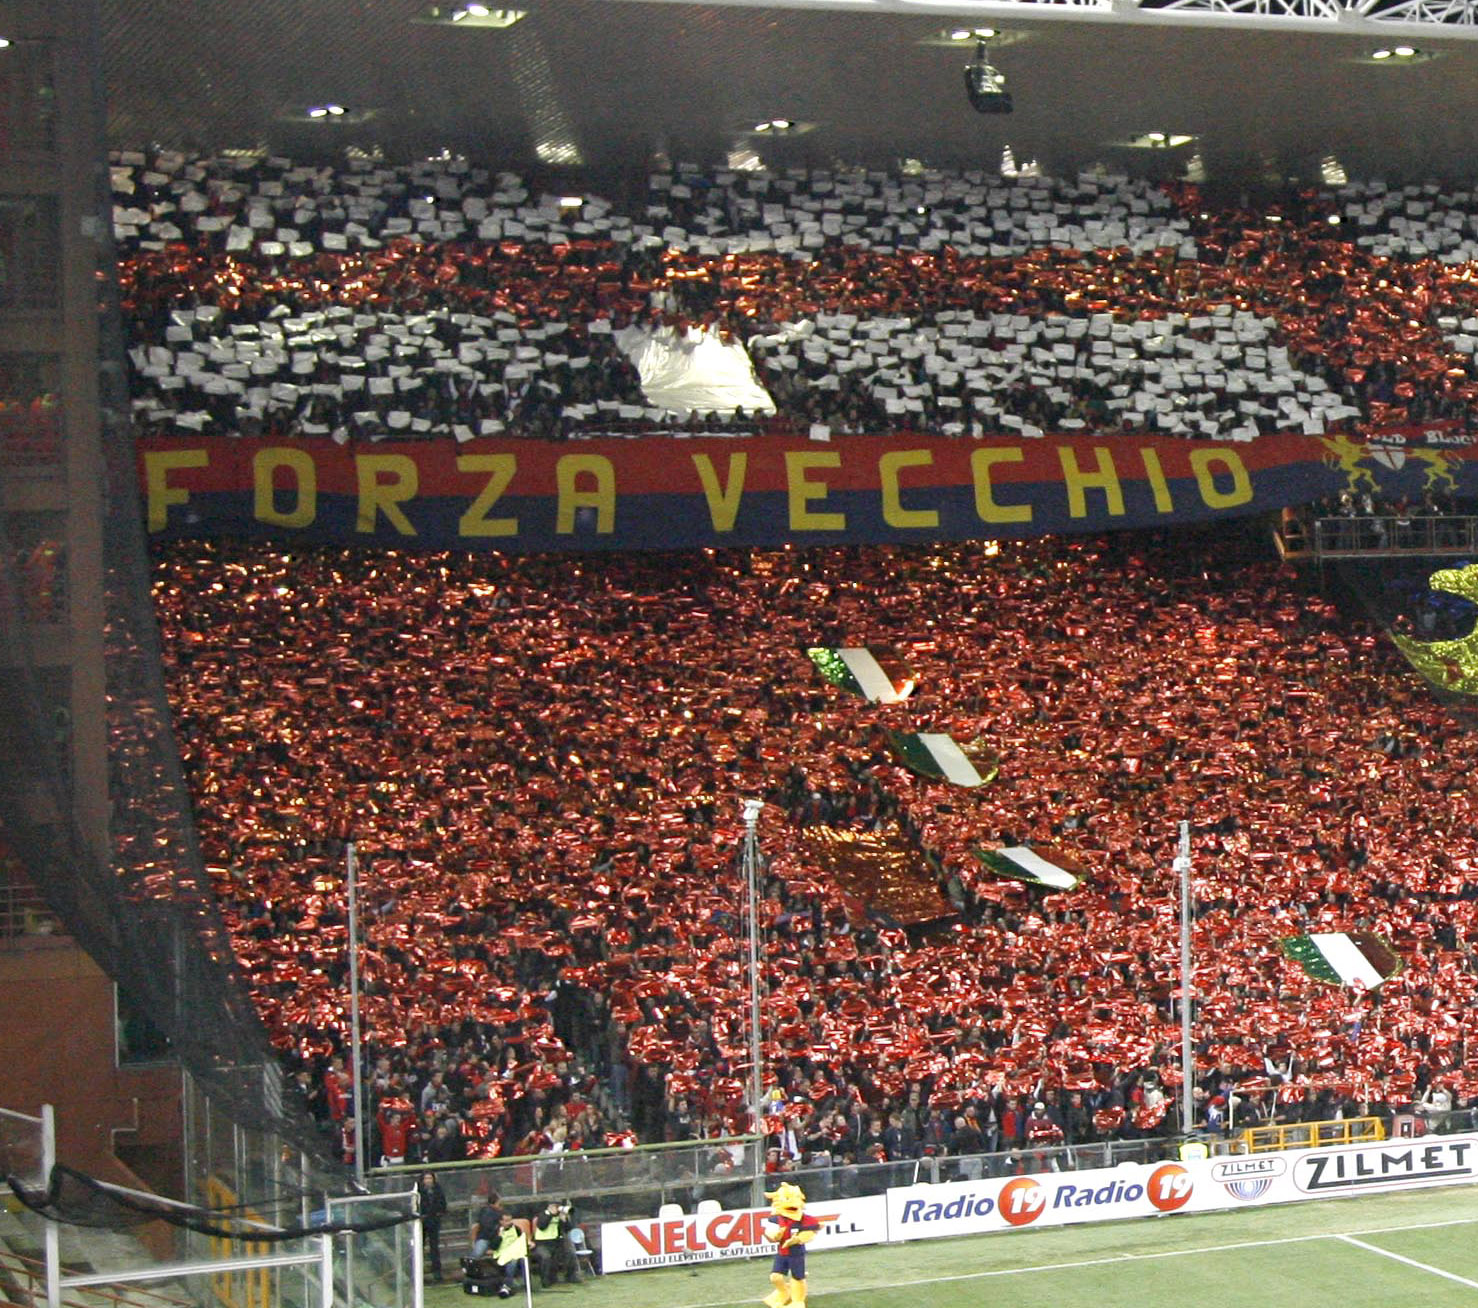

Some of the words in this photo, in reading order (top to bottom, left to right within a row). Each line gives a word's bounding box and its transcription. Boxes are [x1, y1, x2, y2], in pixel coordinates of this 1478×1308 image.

[143, 446, 616, 537] FORZA
[692, 446, 1255, 532] VECCHIO
[1221, 1160, 1275, 1176] ZILMET
[1306, 1142, 1473, 1190] ZILMET
[901, 1194, 995, 1223] Radio
[1009, 1186, 1044, 1214] 19
[1053, 1180, 1143, 1208] Radio
[1158, 1173, 1192, 1201] 19
[625, 1255, 666, 1267] CARRELLI
[668, 1250, 714, 1263] ELEVATORI
[719, 1244, 779, 1258] SCAFFALATUR
